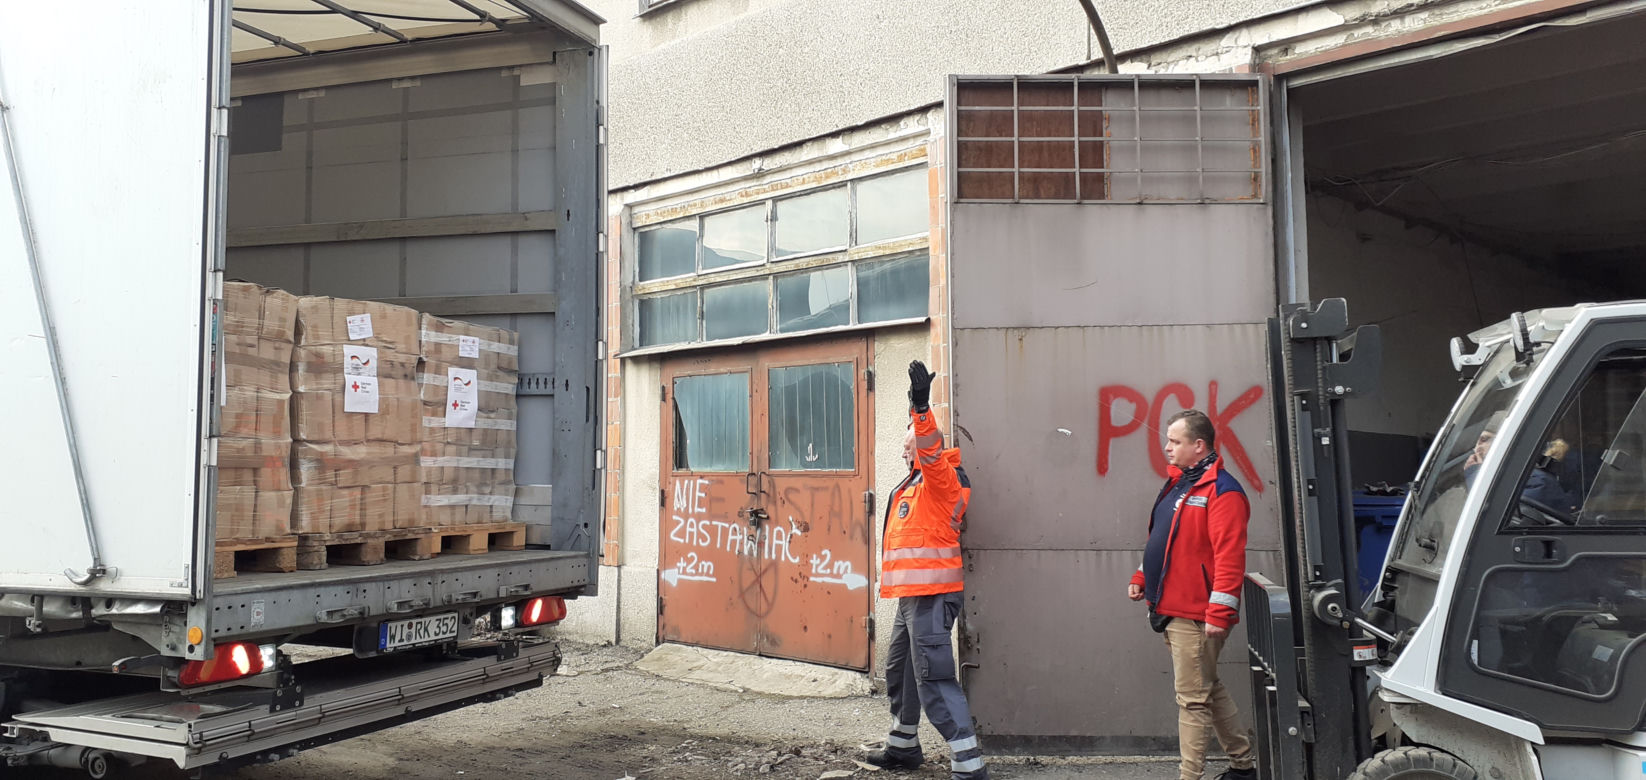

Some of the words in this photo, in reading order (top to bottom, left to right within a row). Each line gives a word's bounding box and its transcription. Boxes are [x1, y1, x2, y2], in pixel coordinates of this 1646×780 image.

[1096, 380, 1264, 494] PCK
[673, 479, 710, 514] NIE
[389, 624, 405, 645] WI
[414, 619, 432, 641] RK
[434, 615, 457, 637] 352
